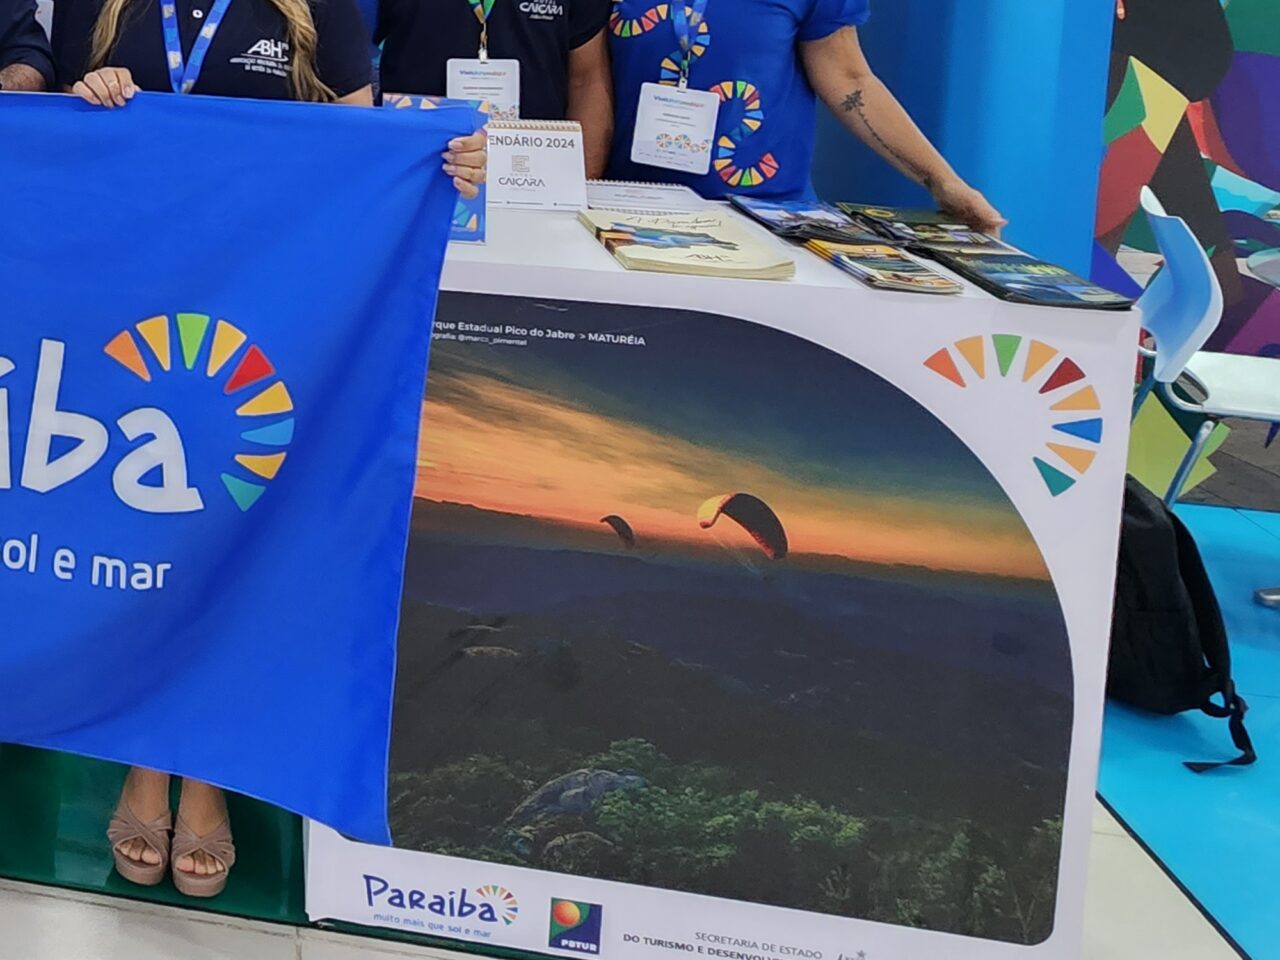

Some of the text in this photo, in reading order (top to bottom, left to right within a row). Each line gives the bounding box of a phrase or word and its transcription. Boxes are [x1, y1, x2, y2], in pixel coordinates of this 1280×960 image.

[546, 138, 575, 148] 2024
[458, 322, 502, 334] Estadual
[505, 326, 527, 336] Pico
[529, 328, 544, 337] do
[545, 329, 575, 340] Jabre
[588, 333, 646, 346] MATURÉIA
[53, 548, 76, 579] e
[91, 553, 172, 590] mar
[373, 913, 400, 924] muito
[403, 917, 425, 928] mais
[428, 922, 444, 932] que
[447, 925, 462, 934] sol
[473, 929, 492, 938] mar
[623, 933, 640, 943] DO
[643, 936, 695, 952] TURISMO
[697, 945, 705, 954] E
[695, 932, 823, 960] SECRETARIA DE ESTADO
